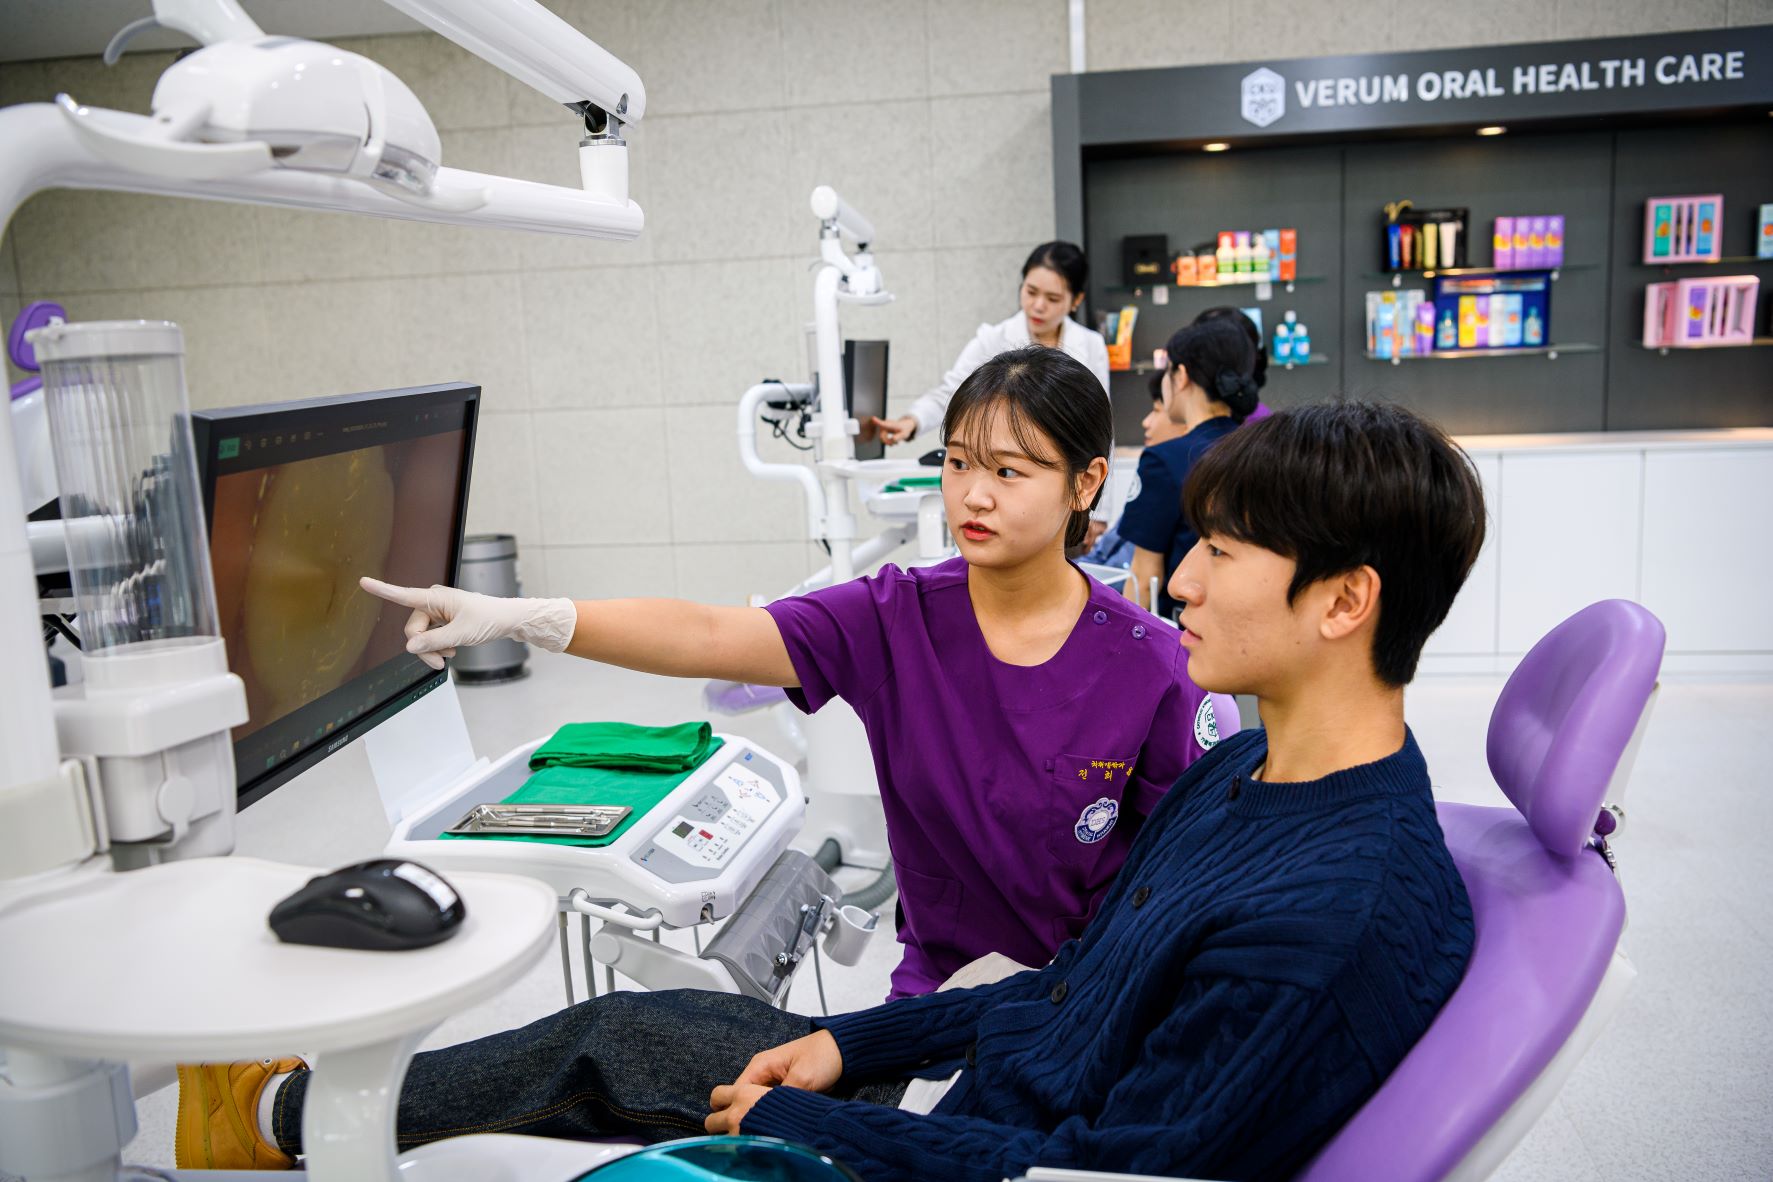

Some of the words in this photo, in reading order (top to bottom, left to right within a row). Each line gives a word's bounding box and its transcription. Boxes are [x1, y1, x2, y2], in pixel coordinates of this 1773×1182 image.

[1296, 74, 1408, 108] VERUM
[1416, 68, 1505, 101] ORAL
[1512, 58, 1645, 95] HEALTH
[1655, 51, 1744, 84] CARE
[328, 734, 348, 753] SAMSUNG
